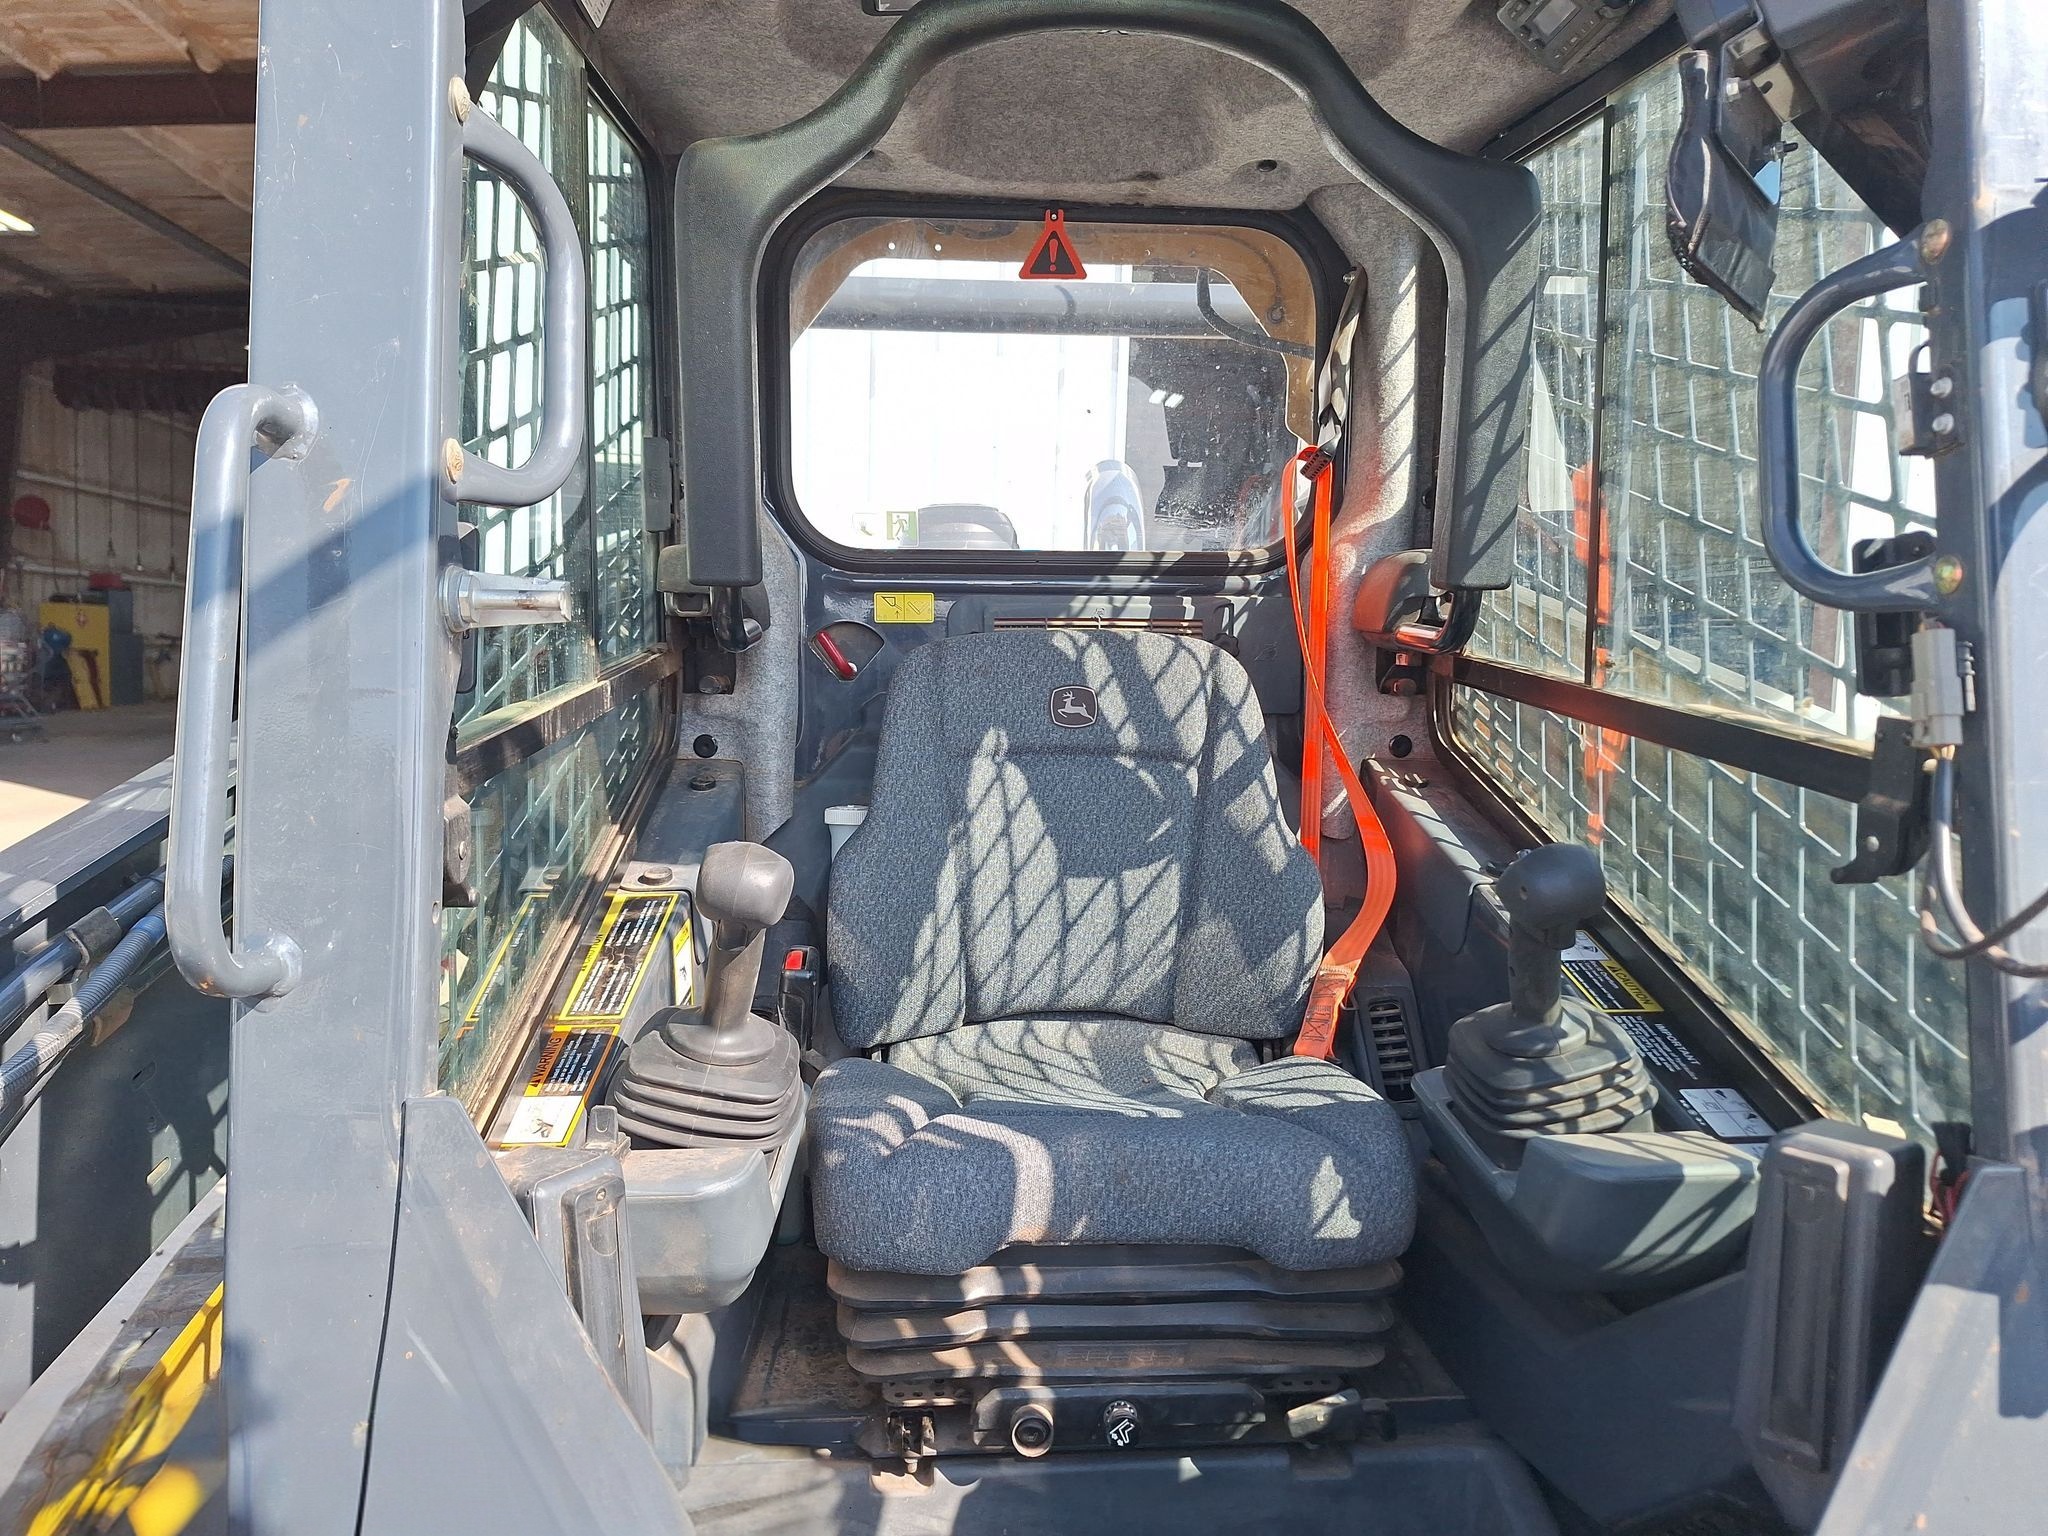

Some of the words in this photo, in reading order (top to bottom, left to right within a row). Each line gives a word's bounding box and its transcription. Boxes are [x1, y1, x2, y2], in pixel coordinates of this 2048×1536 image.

[1616, 968, 1654, 1005] CAUTION
[534, 1037, 562, 1077] WARNING
[1654, 1023, 1701, 1065] IMPORTANT
